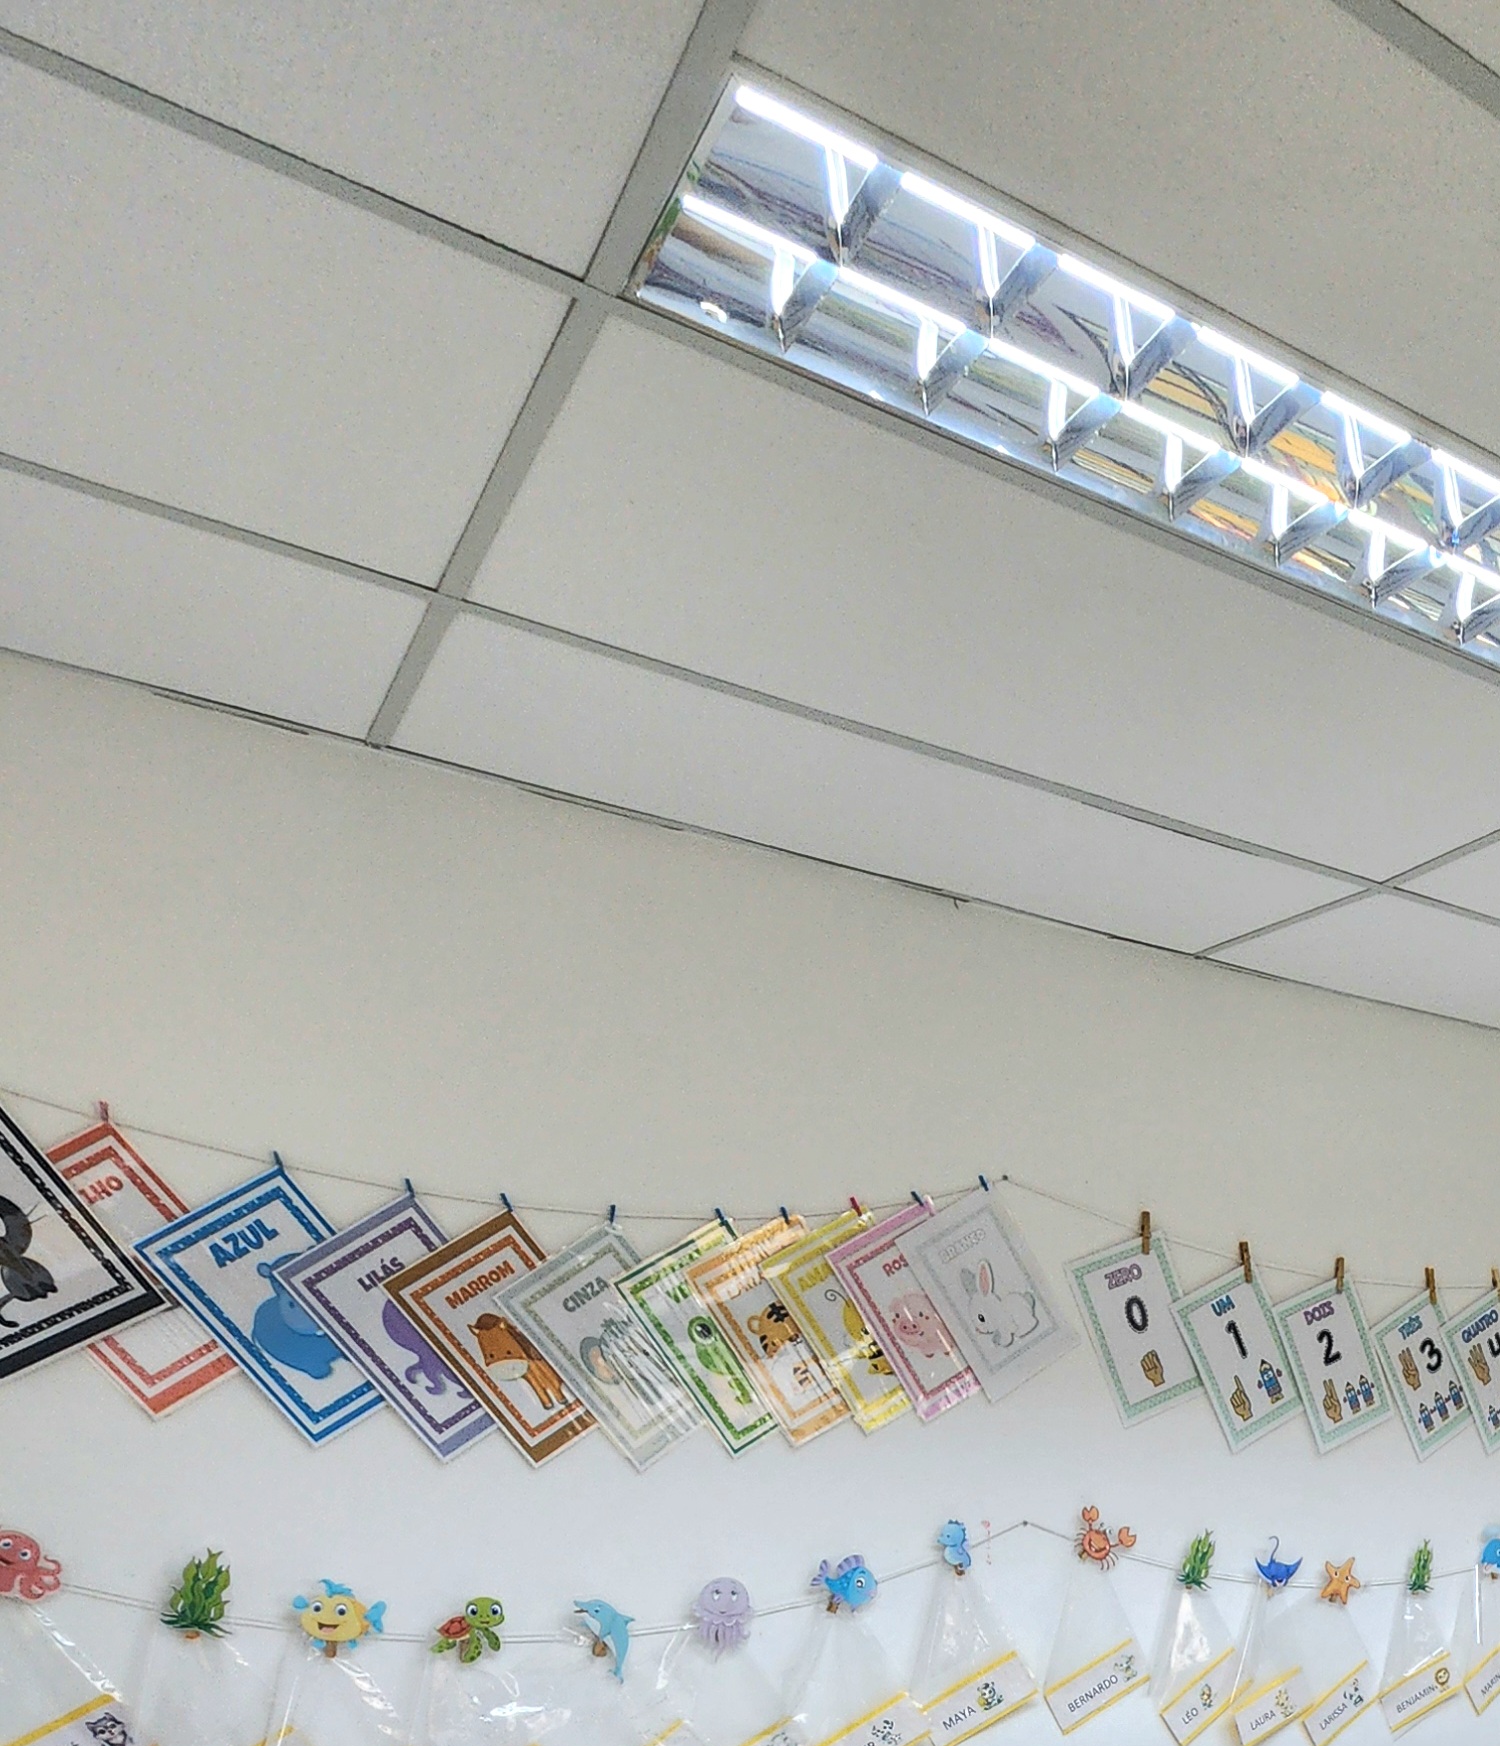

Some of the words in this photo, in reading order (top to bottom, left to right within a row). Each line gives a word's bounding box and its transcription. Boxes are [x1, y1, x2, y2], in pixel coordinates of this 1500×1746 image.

[78, 1176, 123, 1204] LHO
[208, 1218, 280, 1269] AZUL
[357, 1256, 406, 1292] LILÁS
[882, 1252, 909, 1277] ROS
[1105, 1263, 1142, 1290] ZERO
[445, 1260, 515, 1310] MARROM
[562, 1276, 610, 1313] CINZA
[1124, 1295, 1149, 1334] 0
[1211, 1295, 1235, 1317] UM
[1303, 1301, 1334, 1325] DOIS
[1225, 1320, 1248, 1359] 1
[1398, 1315, 1423, 1340] TRÊS
[1461, 1309, 1498, 1343] QUATRO
[1317, 1329, 1342, 1366] 2
[1420, 1337, 1443, 1373] 3
[1068, 1674, 1118, 1712] BERNARDO
[942, 1705, 976, 1731] MAYA
[1182, 1707, 1199, 1725] LÉO
[1250, 1710, 1276, 1730] LAURA
[1319, 1702, 1348, 1730] LARISSA
